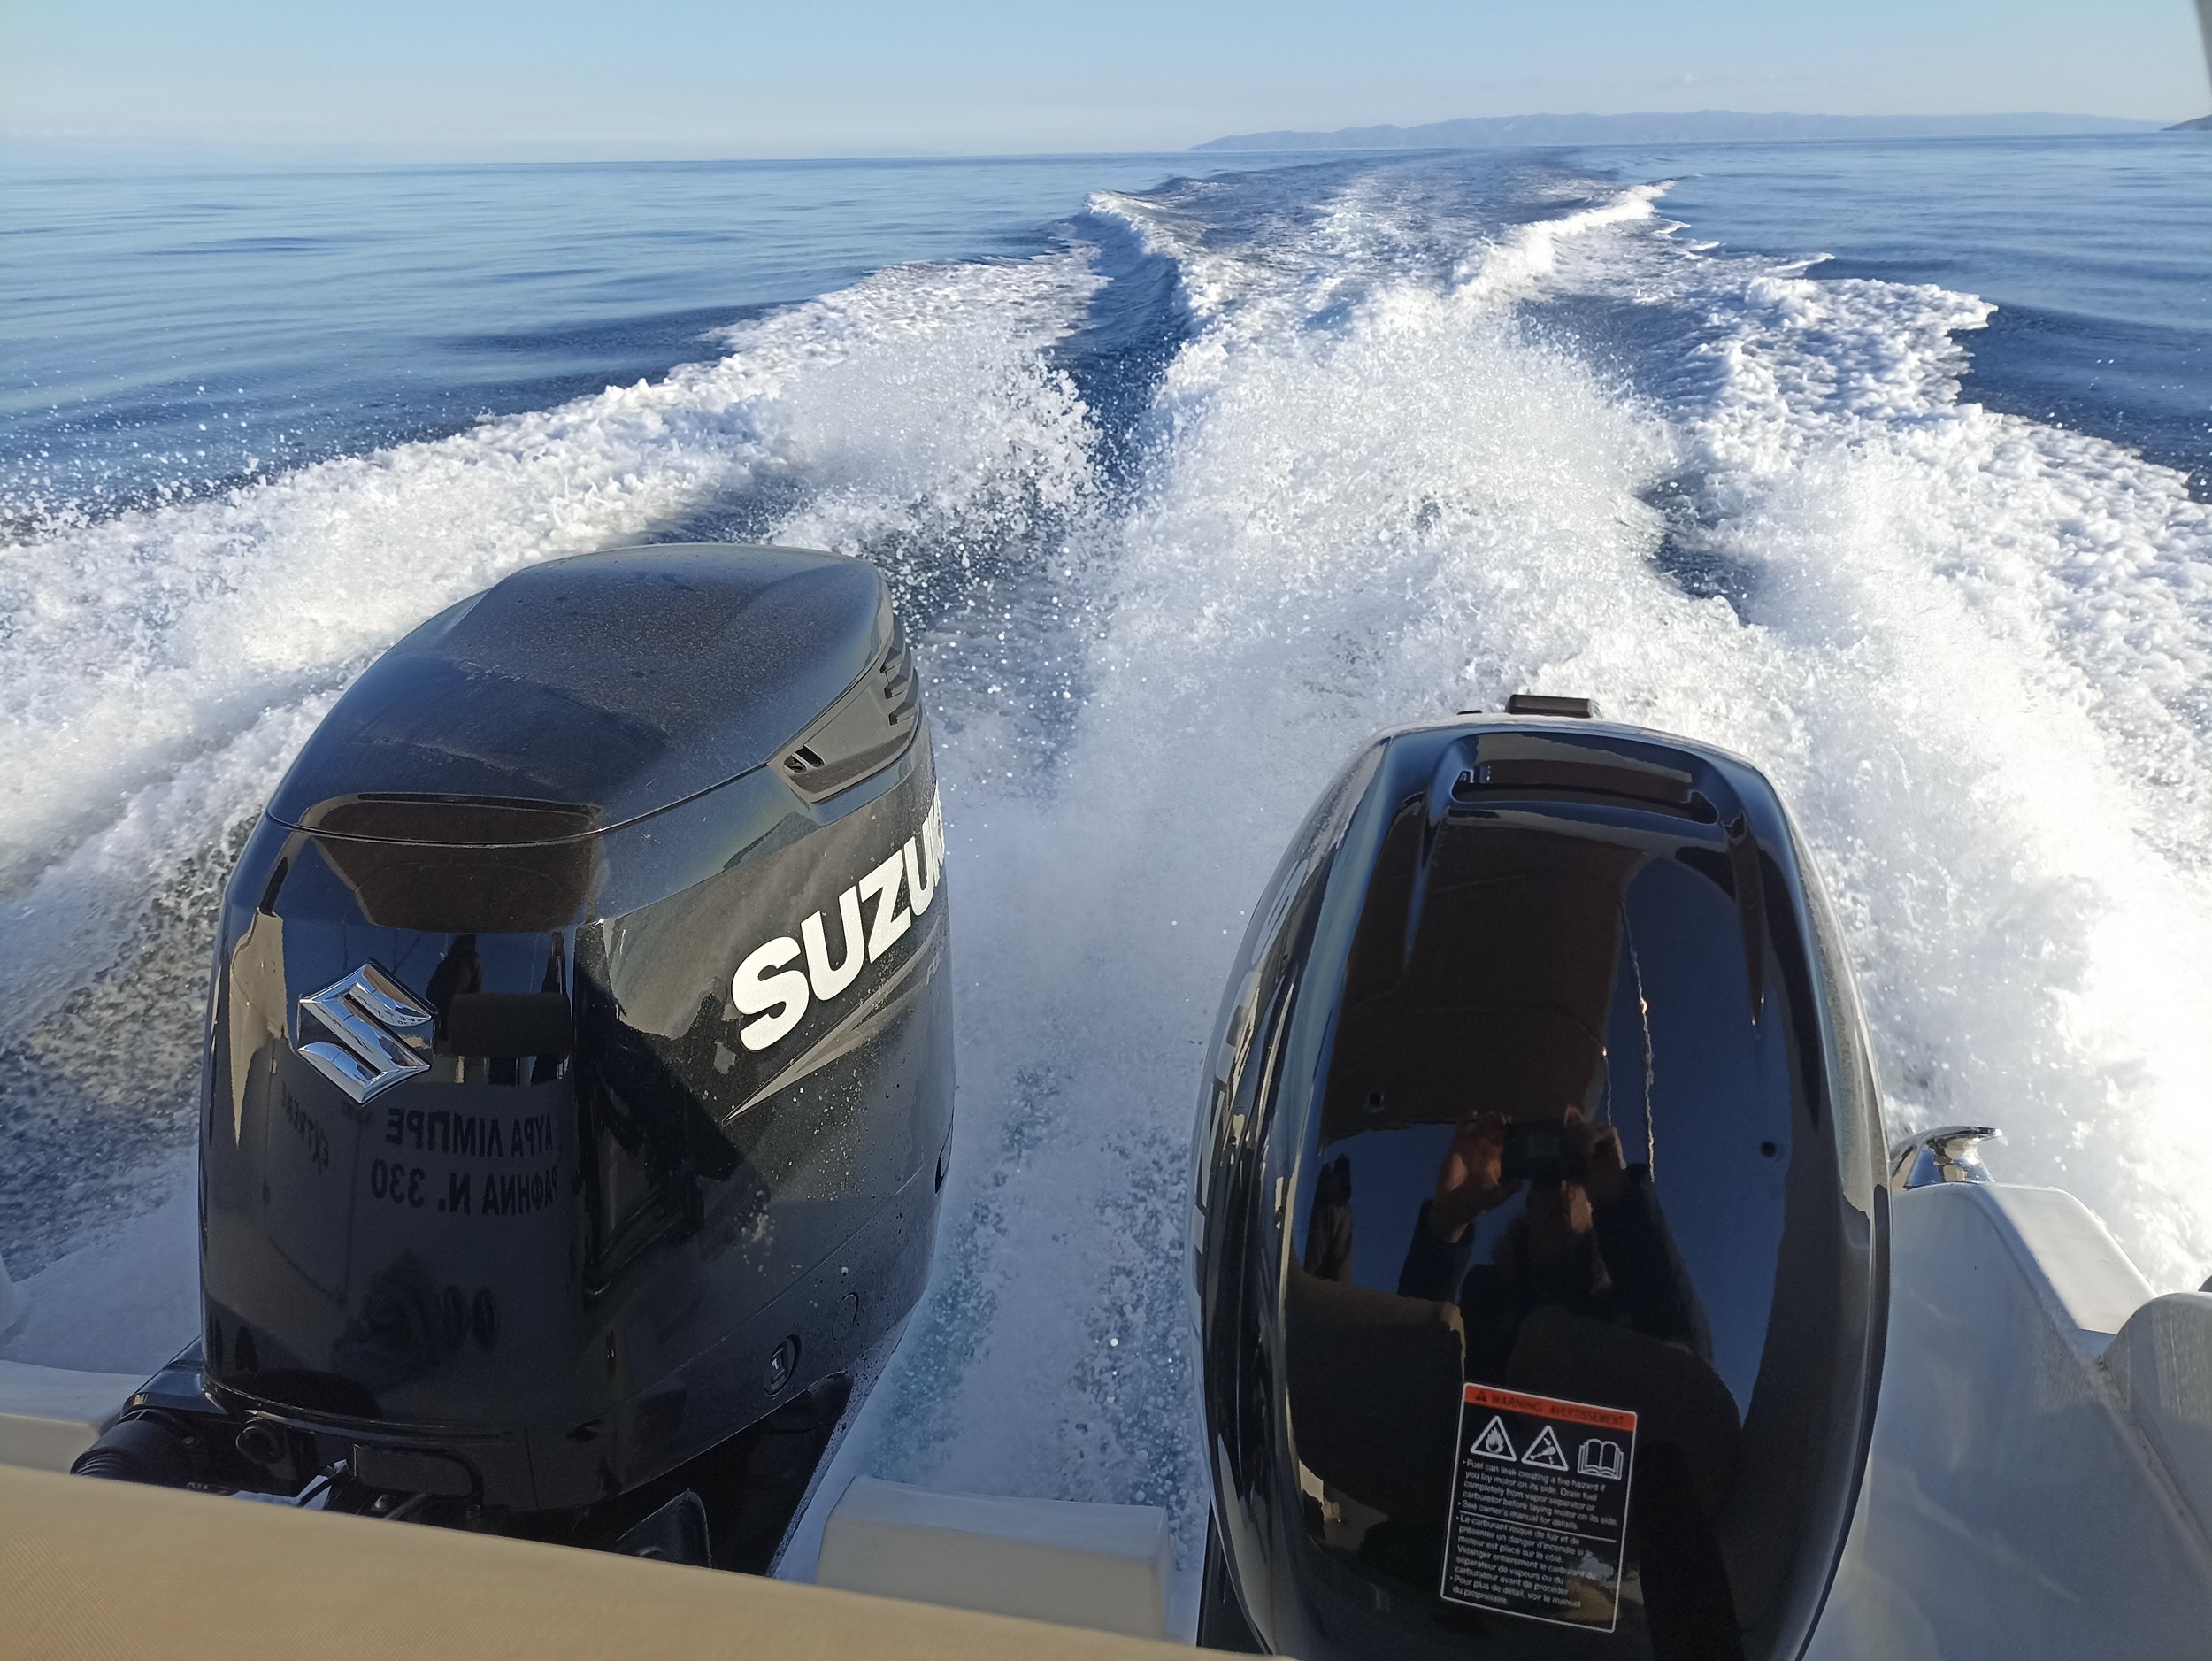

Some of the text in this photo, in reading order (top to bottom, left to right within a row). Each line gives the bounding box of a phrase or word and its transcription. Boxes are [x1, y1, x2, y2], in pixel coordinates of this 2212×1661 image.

[1491, 1394, 1624, 1426] WARNING AVERTISSEMENT
[1466, 1457, 1483, 1469] Fuel
[1485, 1464, 1499, 1473] can
[1571, 1479, 1599, 1491] hazard
[1463, 1480, 1505, 1496] completely
[1506, 1488, 1524, 1498] from
[1548, 1496, 1586, 1512] separator
[1464, 1471, 1479, 1480] you
[1480, 1473, 1493, 1484] lay
[1493, 1476, 1516, 1486] motor
[1559, 1487, 1581, 1498] Drain
[1582, 1492, 1597, 1501] fuel
[1460, 1513, 1470, 1524] Le
[1509, 1510, 1538, 1522] manual
[1553, 1507, 1576, 1519] motor
[1453, 1573, 1472, 1586] Pour
